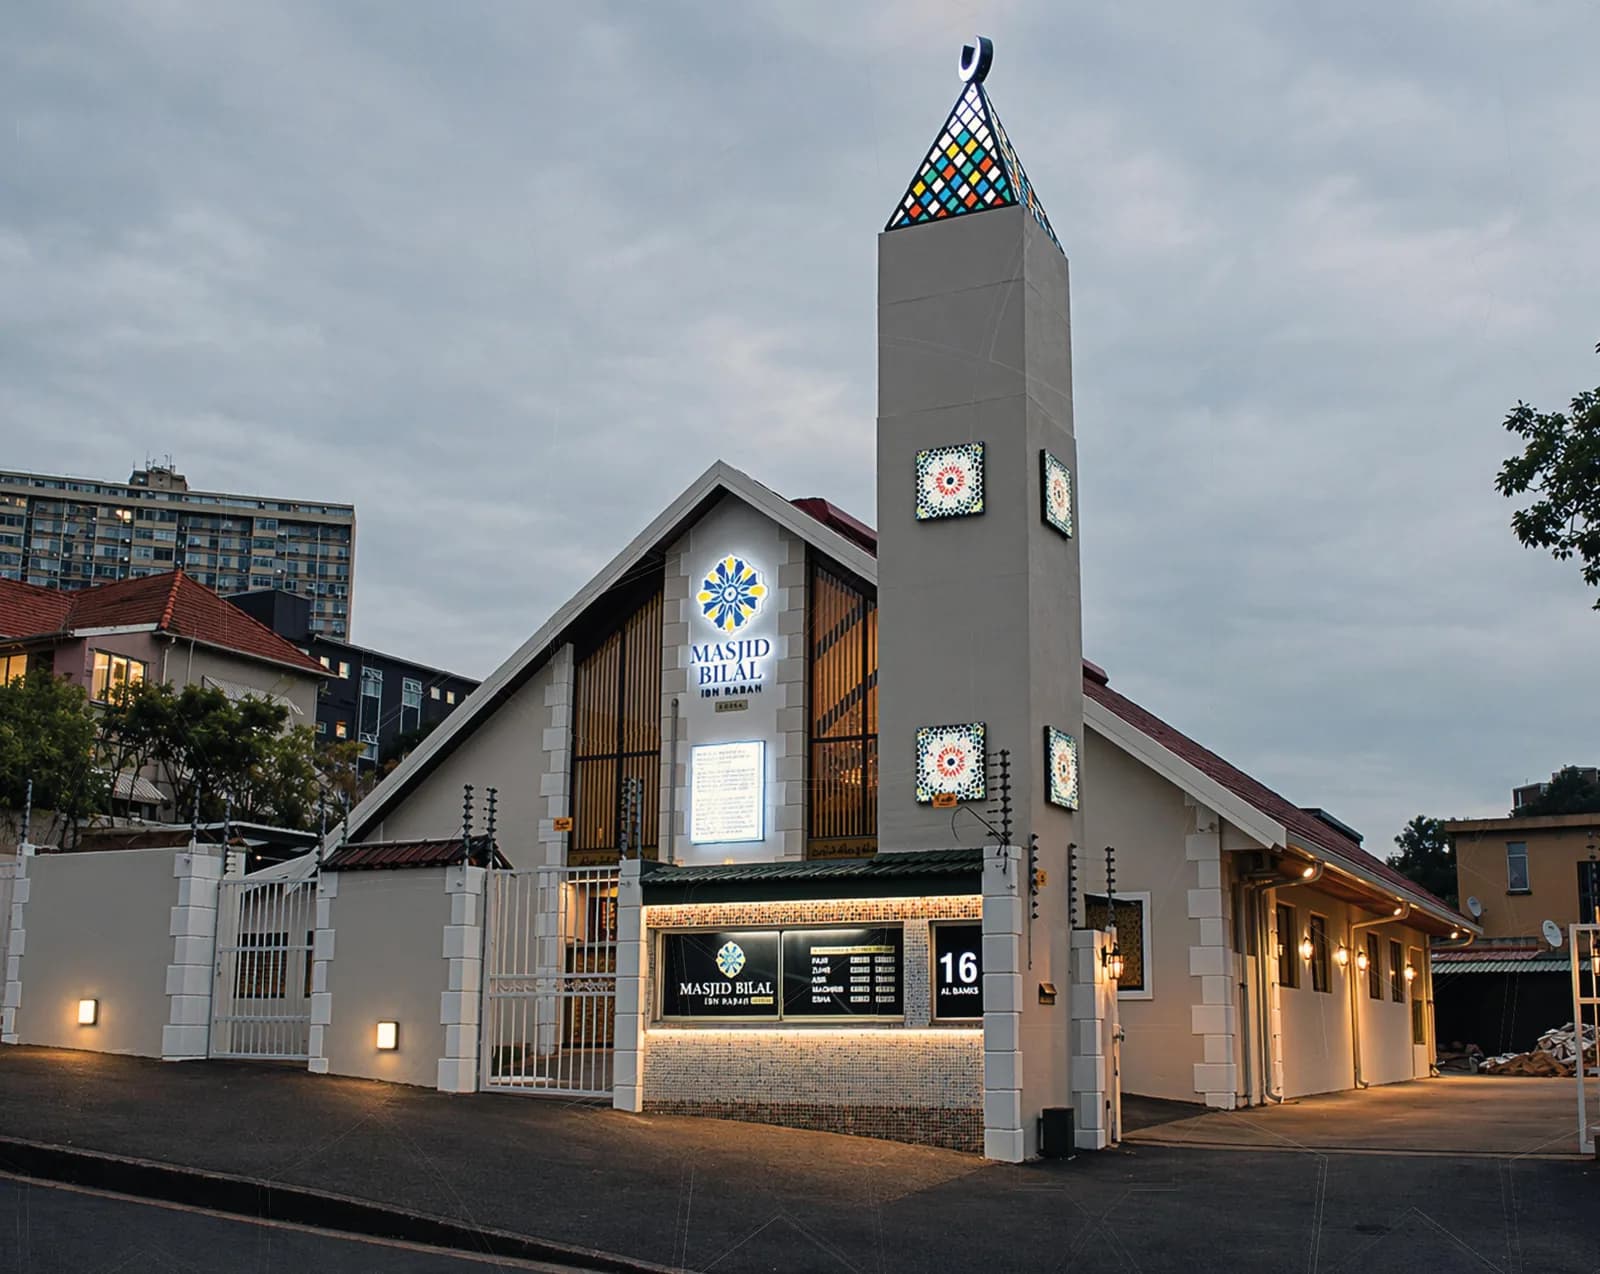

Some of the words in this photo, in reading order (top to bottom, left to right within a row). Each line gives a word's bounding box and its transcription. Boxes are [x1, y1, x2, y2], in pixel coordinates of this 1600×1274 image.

[690, 638, 770, 664] MASJID
[699, 661, 763, 685] BILAL
[940, 952, 978, 984] 16
[679, 982, 732, 997] MASJID
[735, 981, 774, 995] BILAL
